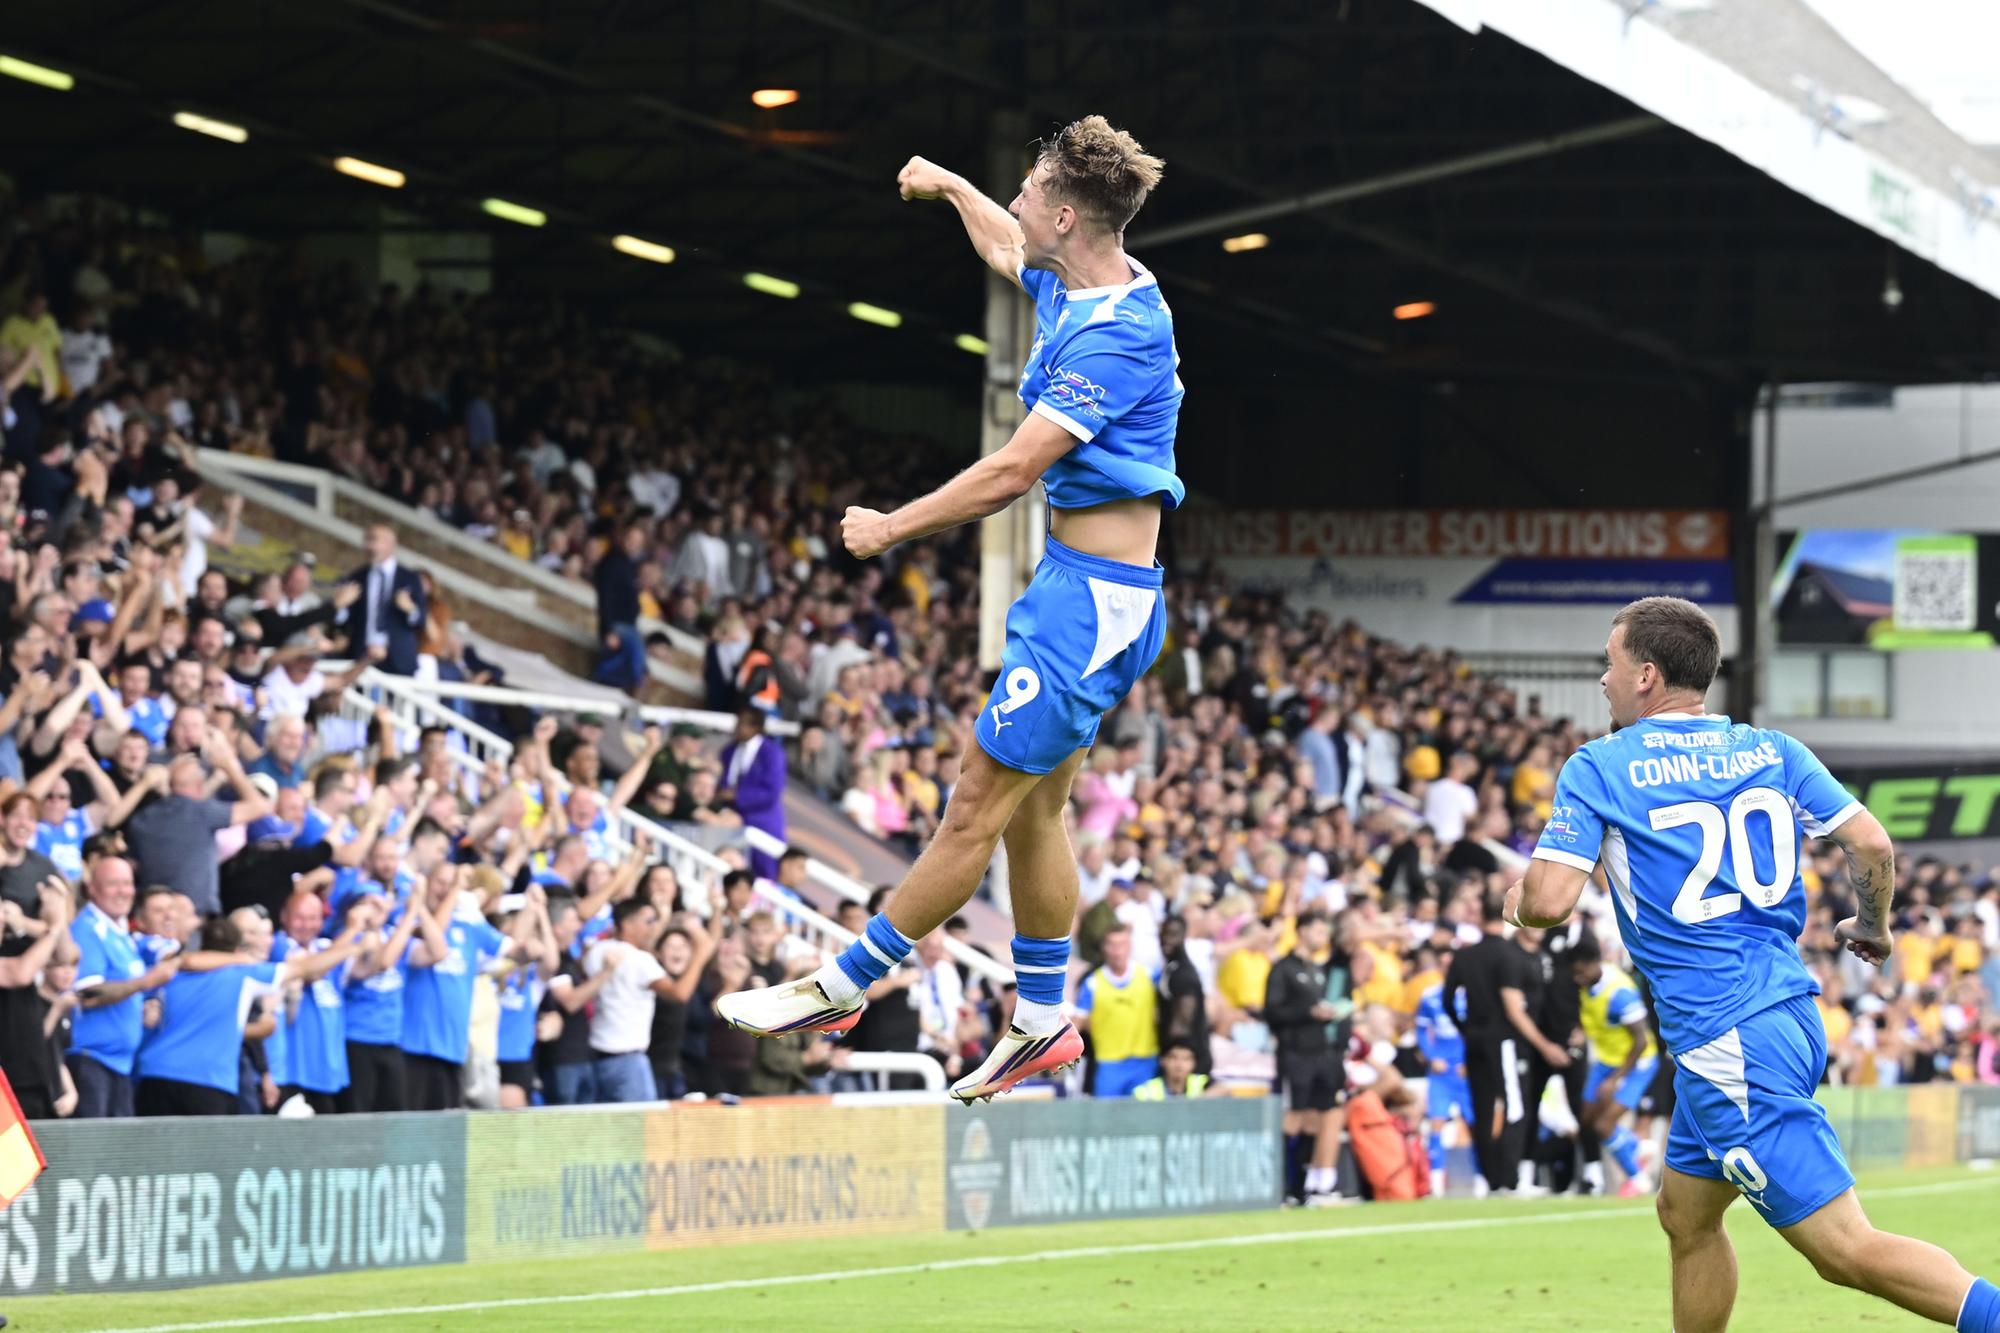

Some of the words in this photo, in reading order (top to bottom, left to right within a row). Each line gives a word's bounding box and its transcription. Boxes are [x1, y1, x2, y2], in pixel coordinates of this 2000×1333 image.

[1287, 510, 1426, 554] POWER
[1437, 510, 1667, 556] SOLUTIONS
[998, 666, 1041, 714] 9
[1628, 741, 1783, 789] CONN-CLARKE
[1843, 774, 2000, 838] ET
[1648, 786, 1796, 925] 20
[1083, 1134, 1162, 1212] POWER
[55, 1172, 222, 1285] POWER
[231, 1159, 446, 1274] SOLUTIONS
